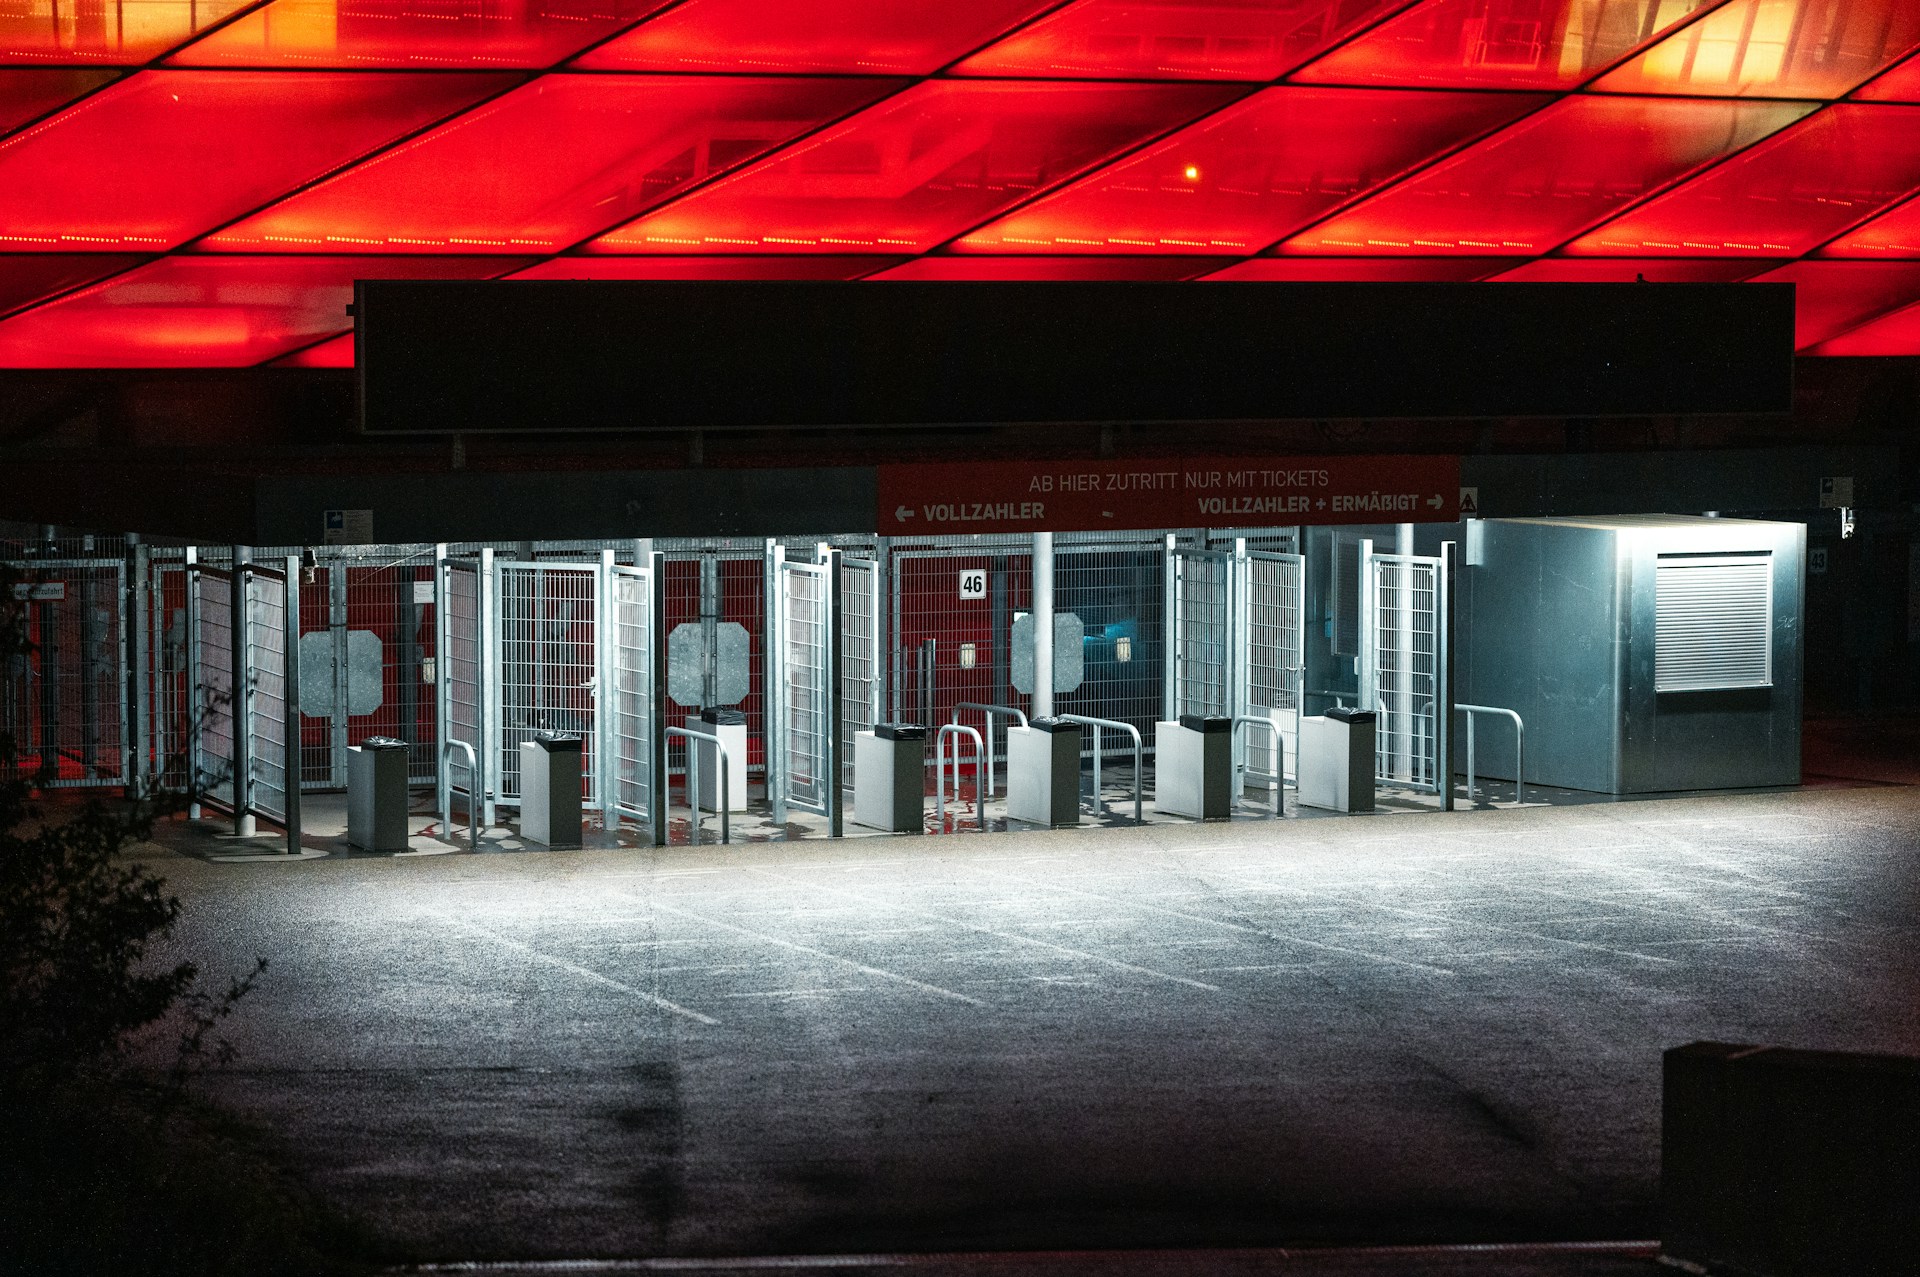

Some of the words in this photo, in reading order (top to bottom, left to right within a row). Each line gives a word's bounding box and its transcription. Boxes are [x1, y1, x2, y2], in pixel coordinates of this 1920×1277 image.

[1028, 475, 1054, 492] AB
[1059, 474, 1101, 492] HIER
[1105, 472, 1179, 491] ZUTRITT
[1185, 471, 1222, 489] NUR
[1227, 470, 1257, 488] MIT
[1260, 469, 1329, 487] TICKETS
[923, 502, 1045, 521] VOLLZAHLER
[1198, 496, 1310, 514] VOLLZAHLER
[1811, 553, 1825, 569] 43
[963, 575, 982, 593] 46
